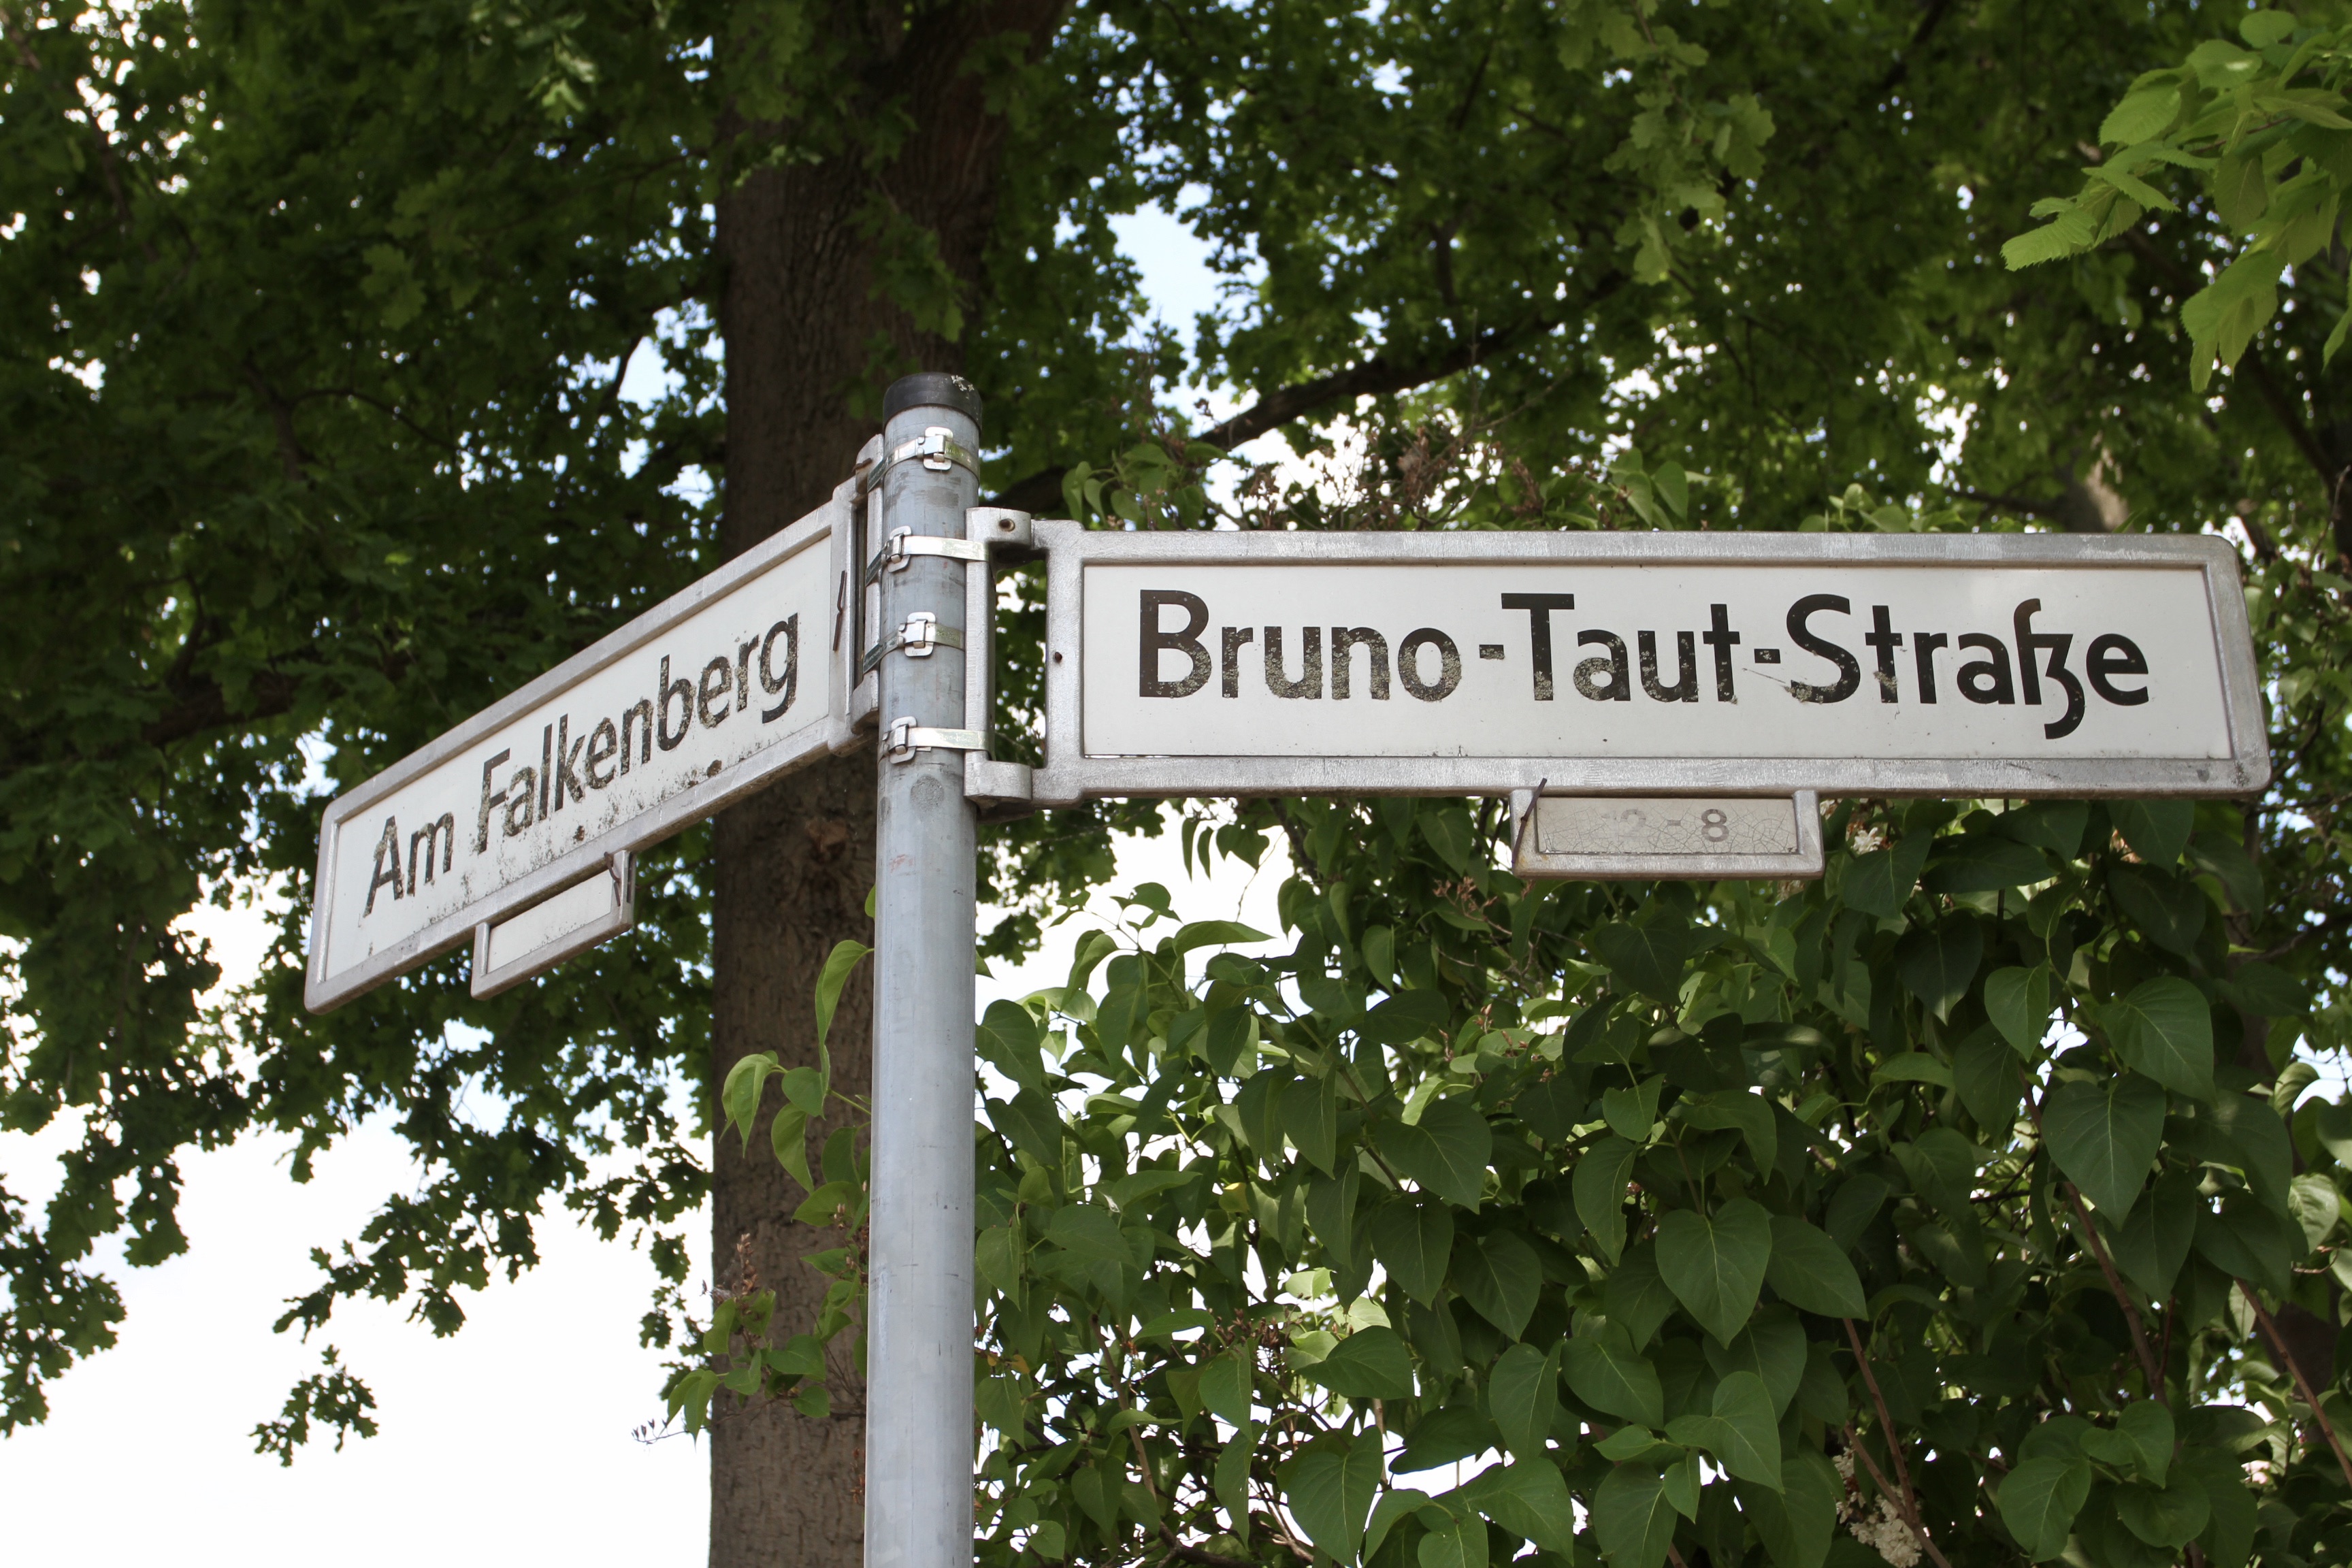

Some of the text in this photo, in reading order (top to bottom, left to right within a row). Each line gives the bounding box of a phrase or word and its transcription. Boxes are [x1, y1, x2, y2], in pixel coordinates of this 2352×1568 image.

[363, 612, 798, 918] Am Falkenberg
[1139, 589, 2149, 740] Bruno-Taut-Straße
